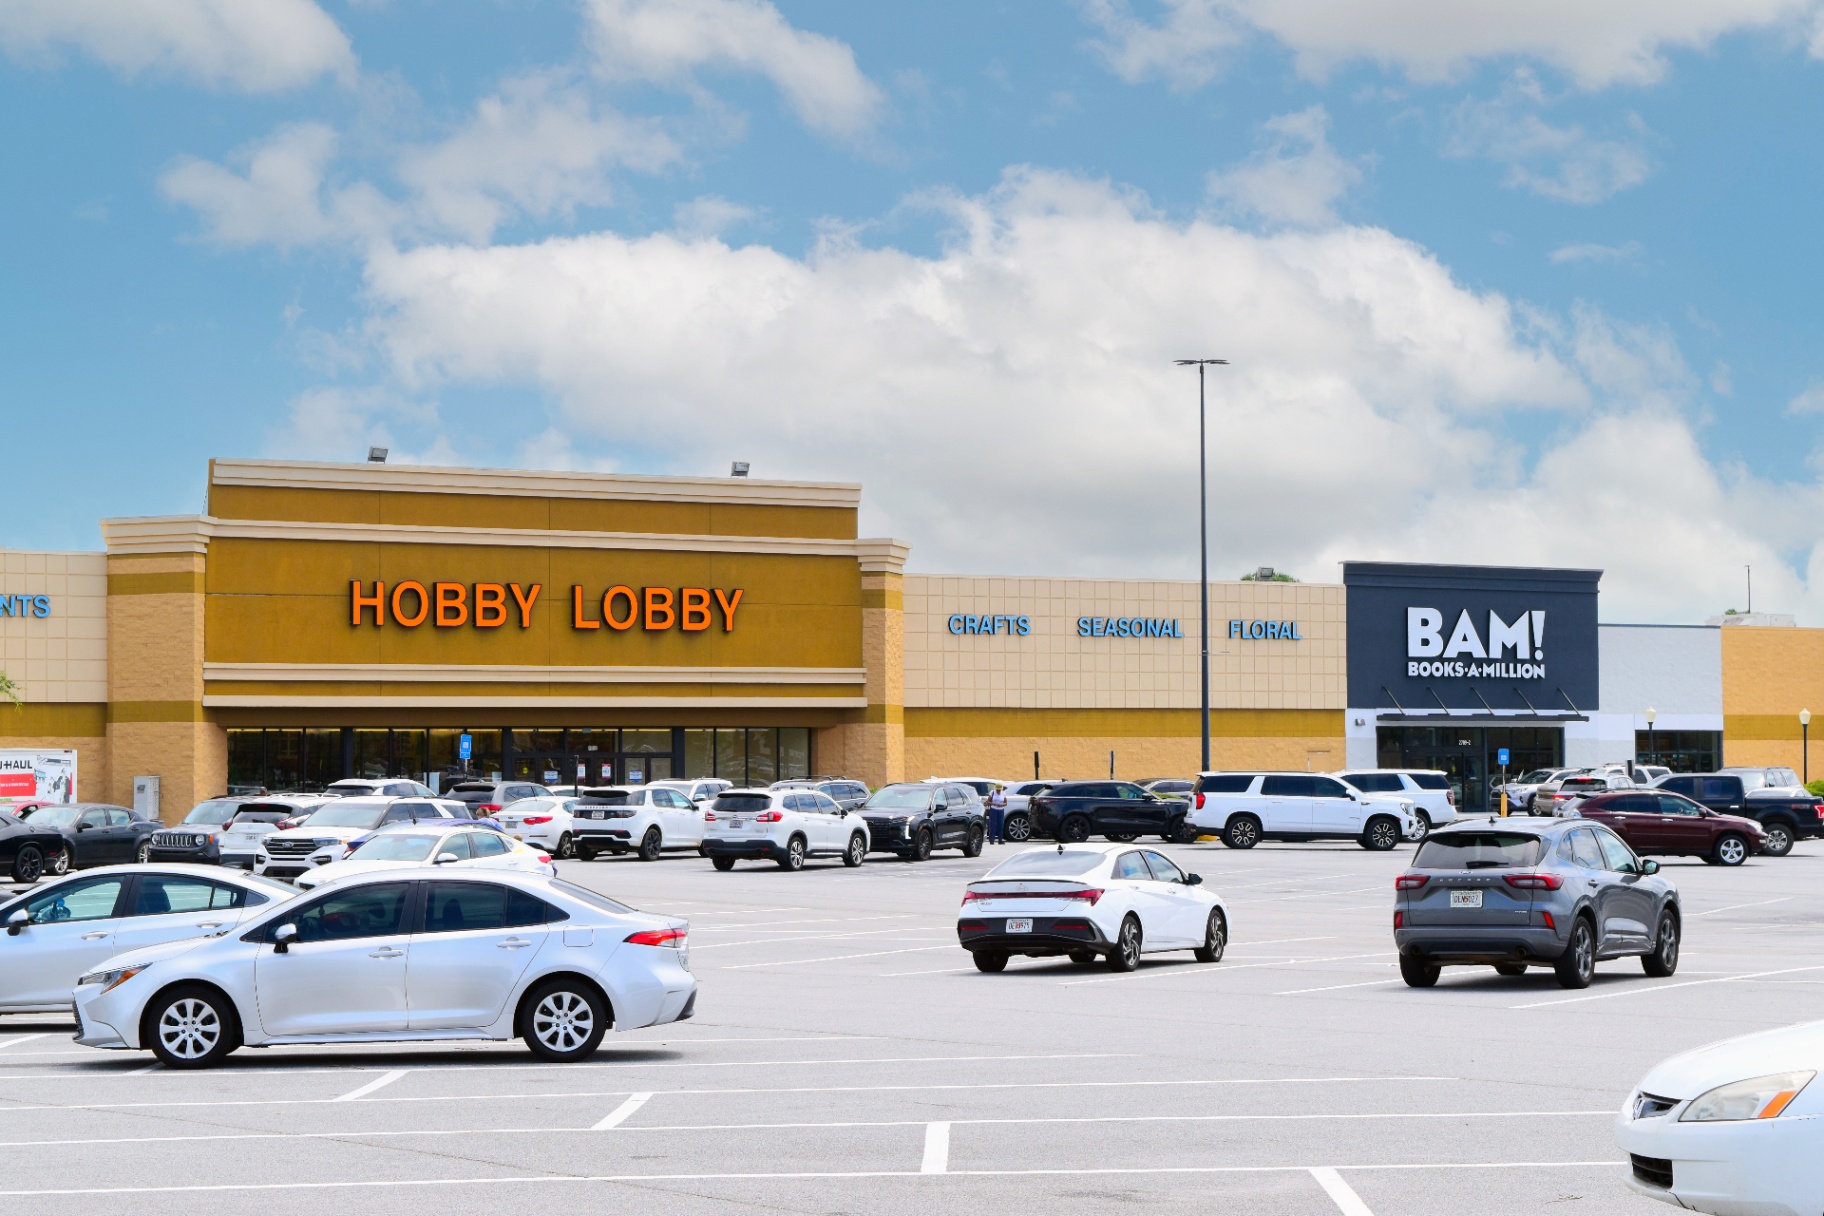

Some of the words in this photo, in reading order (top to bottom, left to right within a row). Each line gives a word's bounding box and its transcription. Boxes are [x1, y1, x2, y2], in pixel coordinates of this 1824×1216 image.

[351, 580, 541, 628] HOBBY
[572, 584, 743, 633] LOBBY
[948, 613, 1031, 636] CRAFTS
[1077, 616, 1185, 638] SEASONAL
[1229, 619, 1303, 640] FLORAL
[1407, 606, 1546, 661] BAM!
